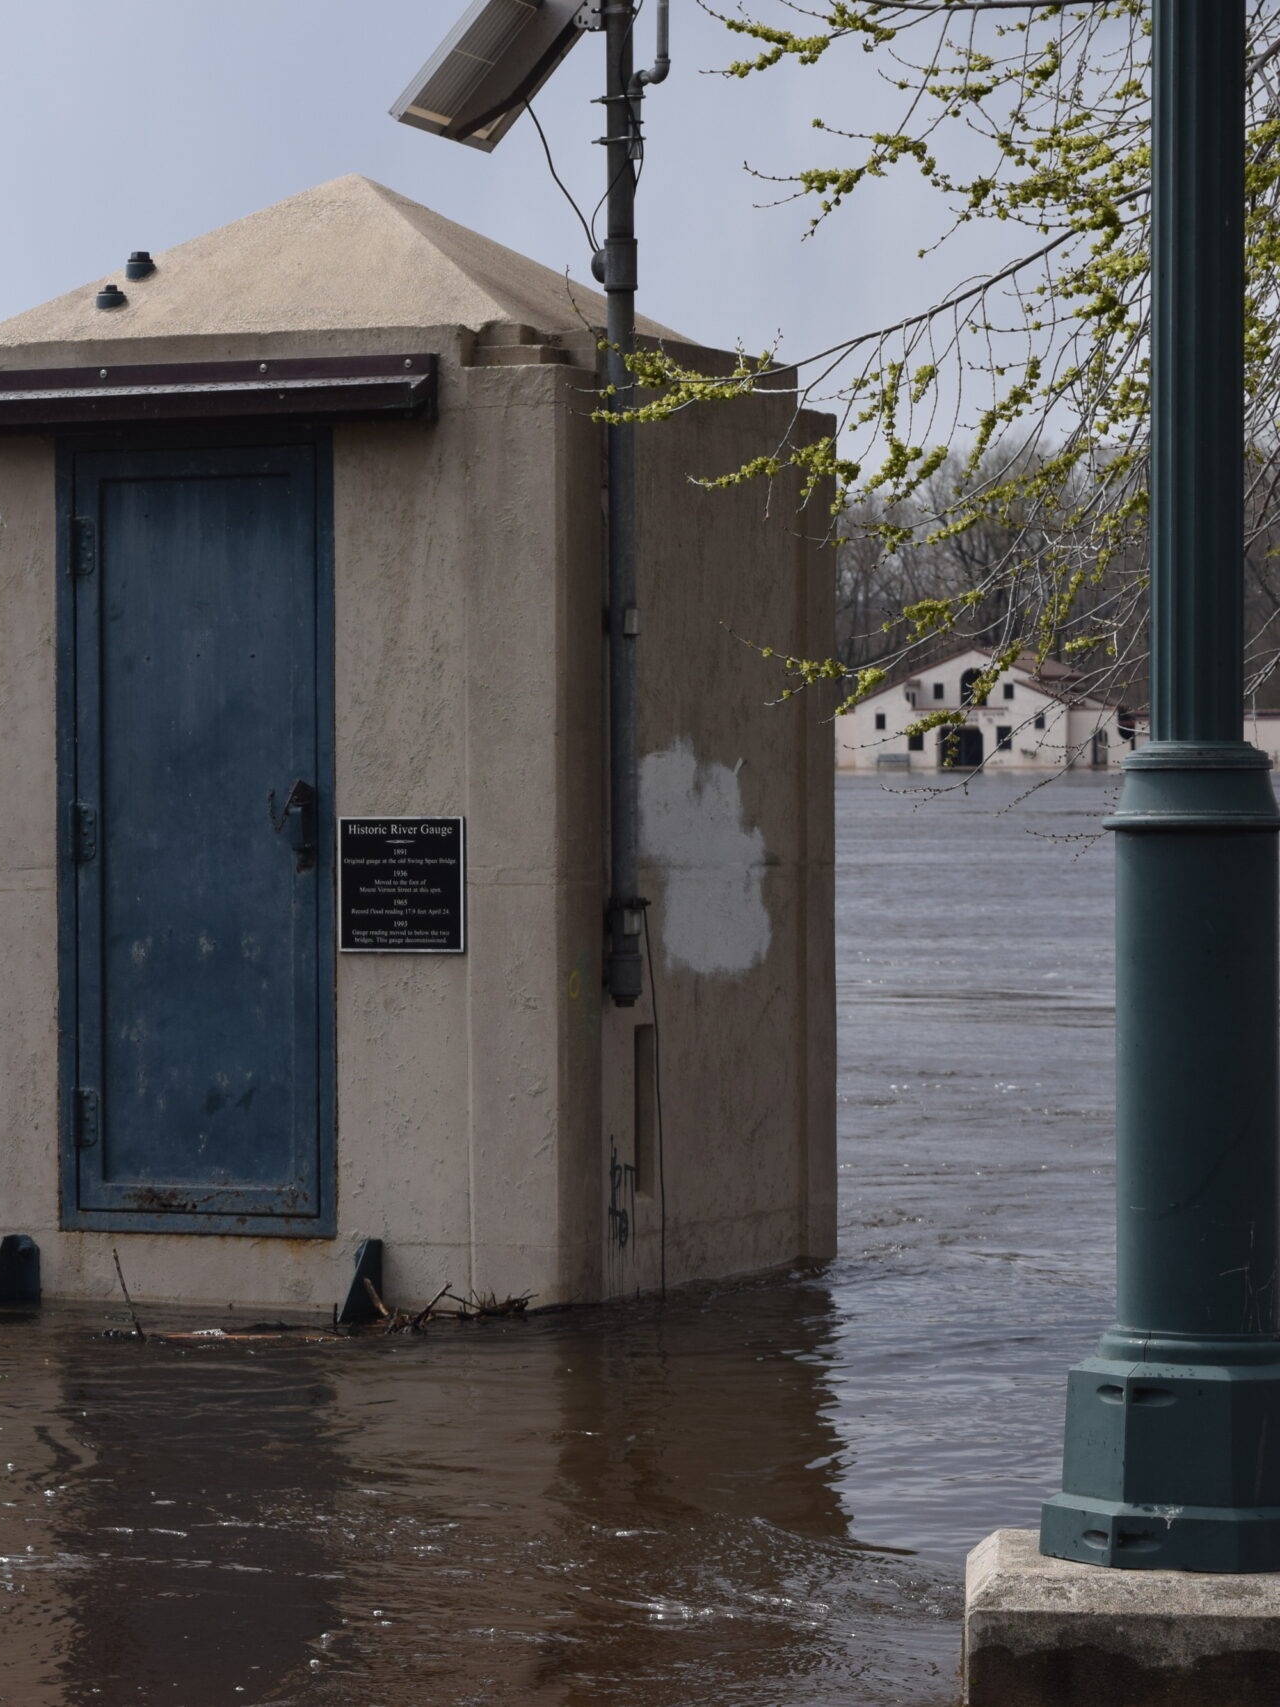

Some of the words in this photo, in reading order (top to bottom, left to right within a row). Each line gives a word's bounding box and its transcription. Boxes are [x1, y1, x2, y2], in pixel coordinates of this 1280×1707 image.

[348, 824, 387, 835] Historic
[391, 824, 417, 835] River
[420, 824, 453, 837] Gauge
